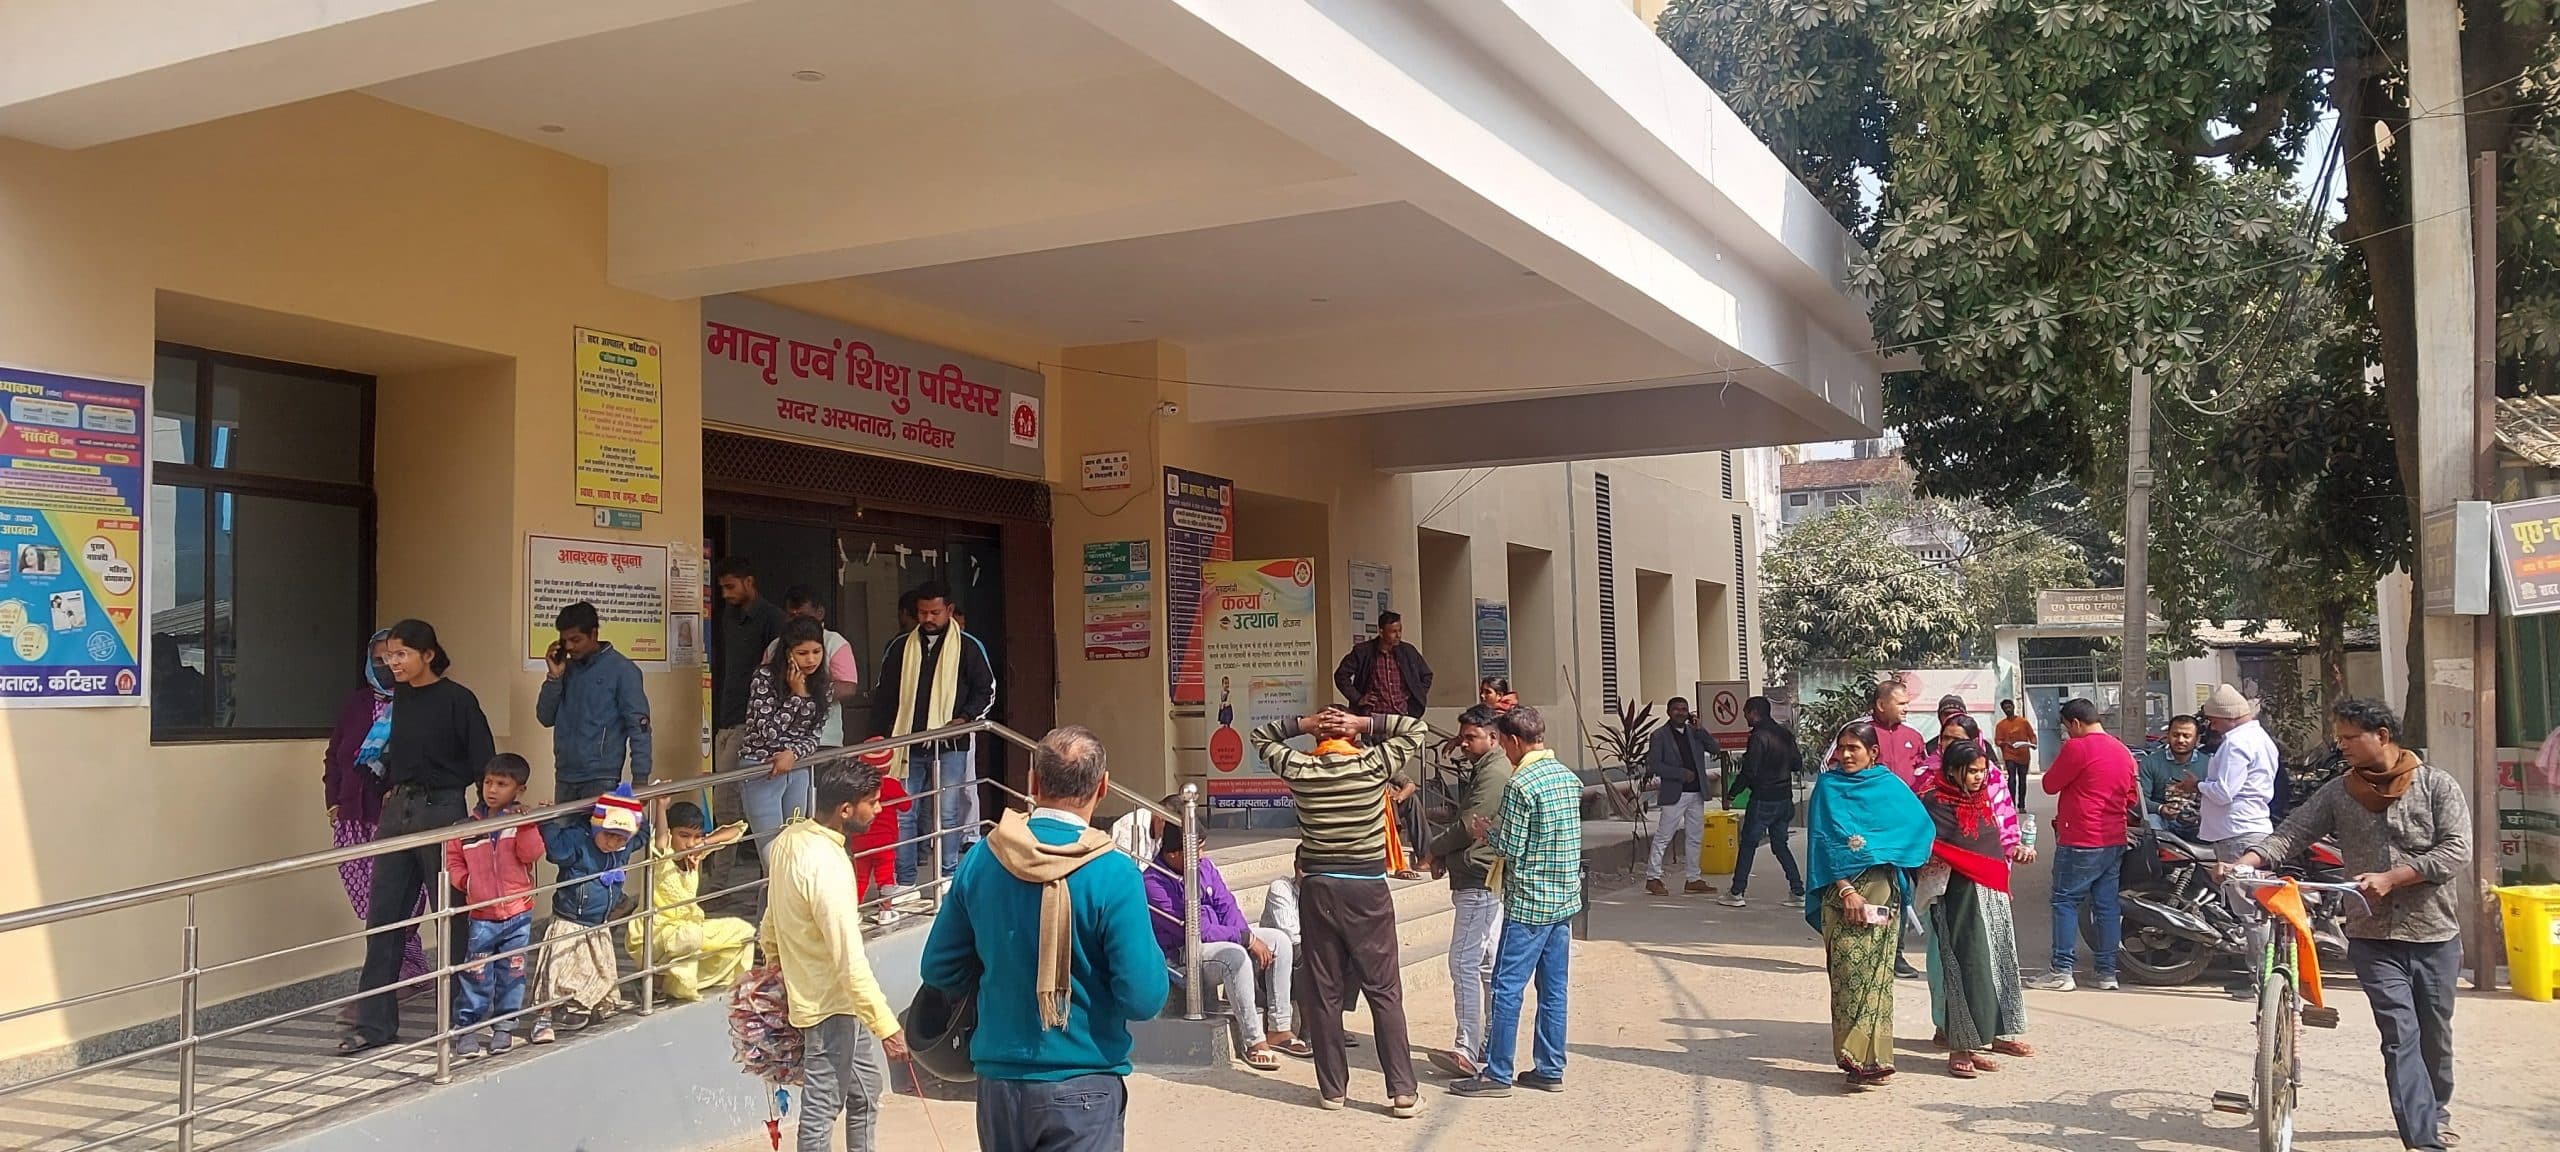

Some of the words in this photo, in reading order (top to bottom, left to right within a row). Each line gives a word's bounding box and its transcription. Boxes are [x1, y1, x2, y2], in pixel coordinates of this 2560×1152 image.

[706, 321, 780, 385] मातृ
[788, 338, 842, 381] एवं
[845, 341, 911, 415] शिशु
[918, 364, 1001, 416] परिसर
[777, 398, 818, 424] सदर
[821, 407, 896, 440] अस्पताल,
[902, 418, 955, 448] कटिहार
[558, 550, 609, 566] आवश्यक
[610, 553, 643, 574] सूचना
[1222, 595, 1260, 610] कन्या
[1233, 612, 1279, 629] उत्थान
[48, 669, 107, 691] कटिहार
[1218, 799, 1235, 807] सदर
